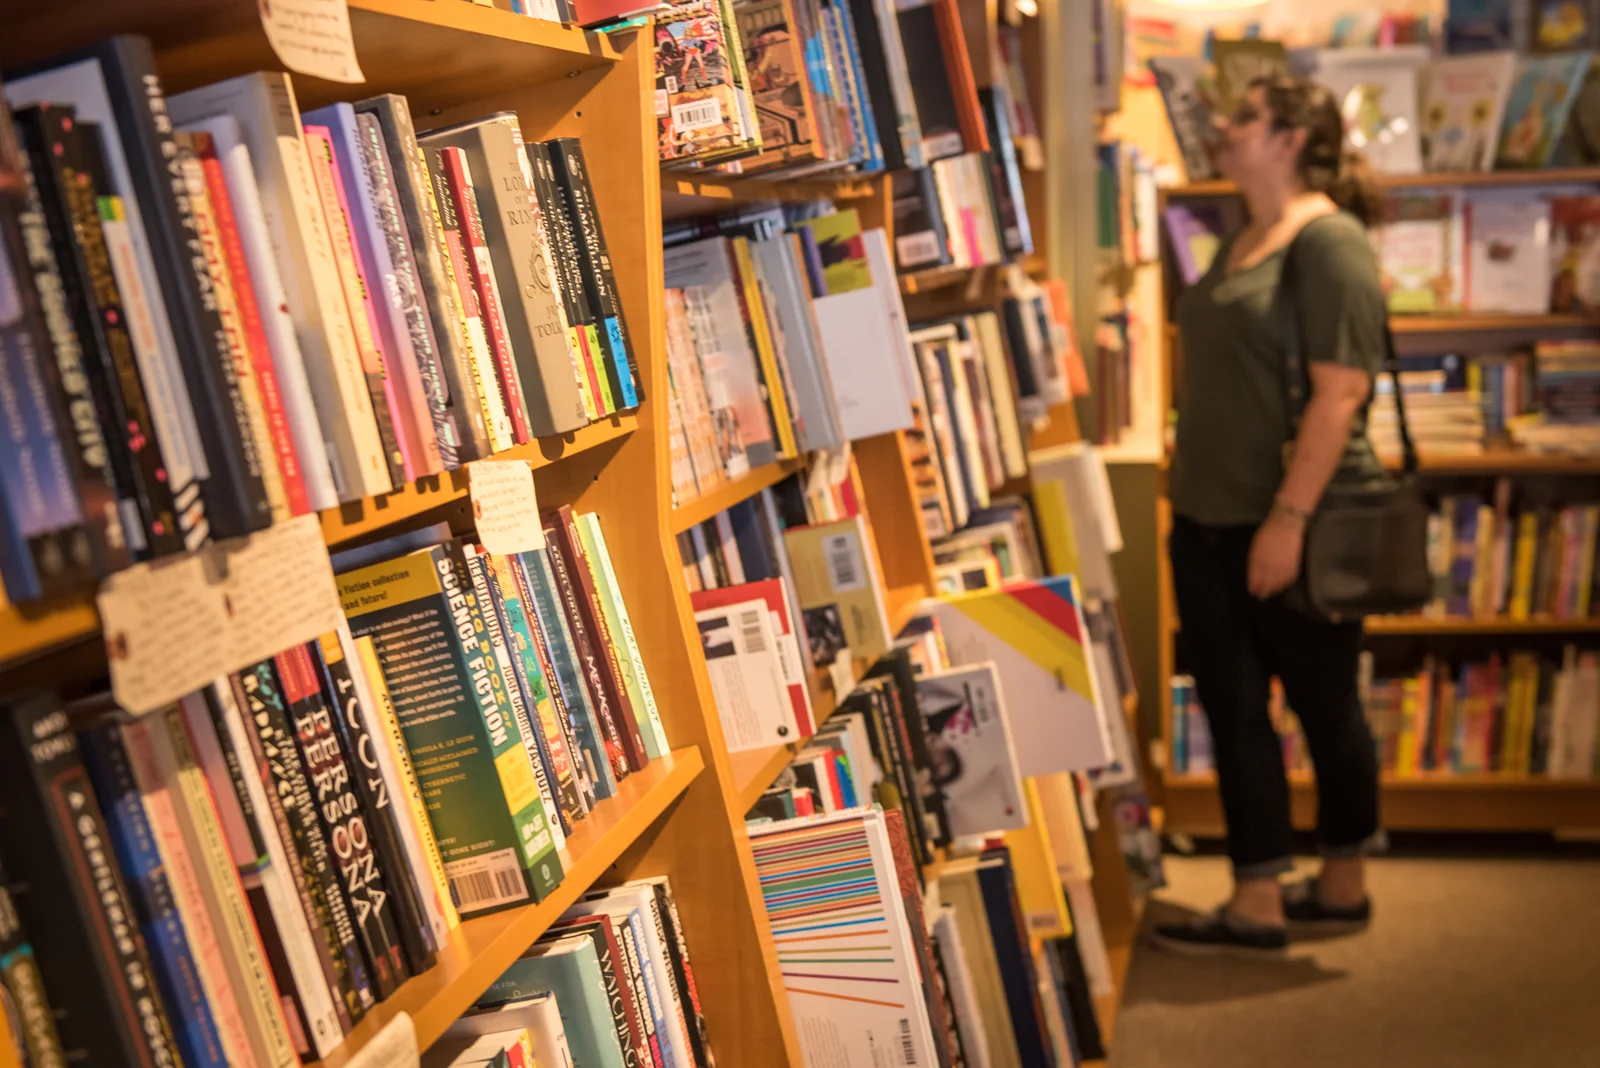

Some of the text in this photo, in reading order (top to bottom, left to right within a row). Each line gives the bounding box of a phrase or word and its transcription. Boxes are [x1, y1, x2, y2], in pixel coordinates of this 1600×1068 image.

[143, 73, 217, 310] HER EVERY FEAR
[463, 187, 477, 238] Brooklyn
[503, 177, 526, 192] LOR
[508, 209, 532, 225] RIN
[574, 189, 605, 295] SILMARILLION
[195, 214, 250, 377] AMY TAN
[484, 282, 500, 329] COLM
[213, 330, 236, 384] PETER
[344, 599, 358, 609] and
[437, 557, 508, 746] SCIENCE FICTION
[466, 555, 504, 646] REPUTATIONS
[498, 598, 513, 636] Good
[589, 594, 626, 695] Radiant Terminus
[464, 593, 484, 632] BIG
[477, 640, 508, 703] BOOK
[501, 710, 512, 729] OF
[502, 665, 518, 692] JUAN
[512, 696, 533, 741] GABRIEL
[586, 655, 621, 751] MENAGERIE
[621, 618, 659, 722] KURT VONNEGUT
[242, 673, 296, 808] RADIANCE
[382, 694, 420, 799] AUTHORITY
[292, 714, 377, 926] PERSONA
[308, 706, 391, 916] PERSONA
[622, 927, 641, 975] CHUCK
[633, 976, 656, 1034] WENDIG
[630, 914, 650, 962] CHUCK
[642, 962, 665, 1020] WENDIG
